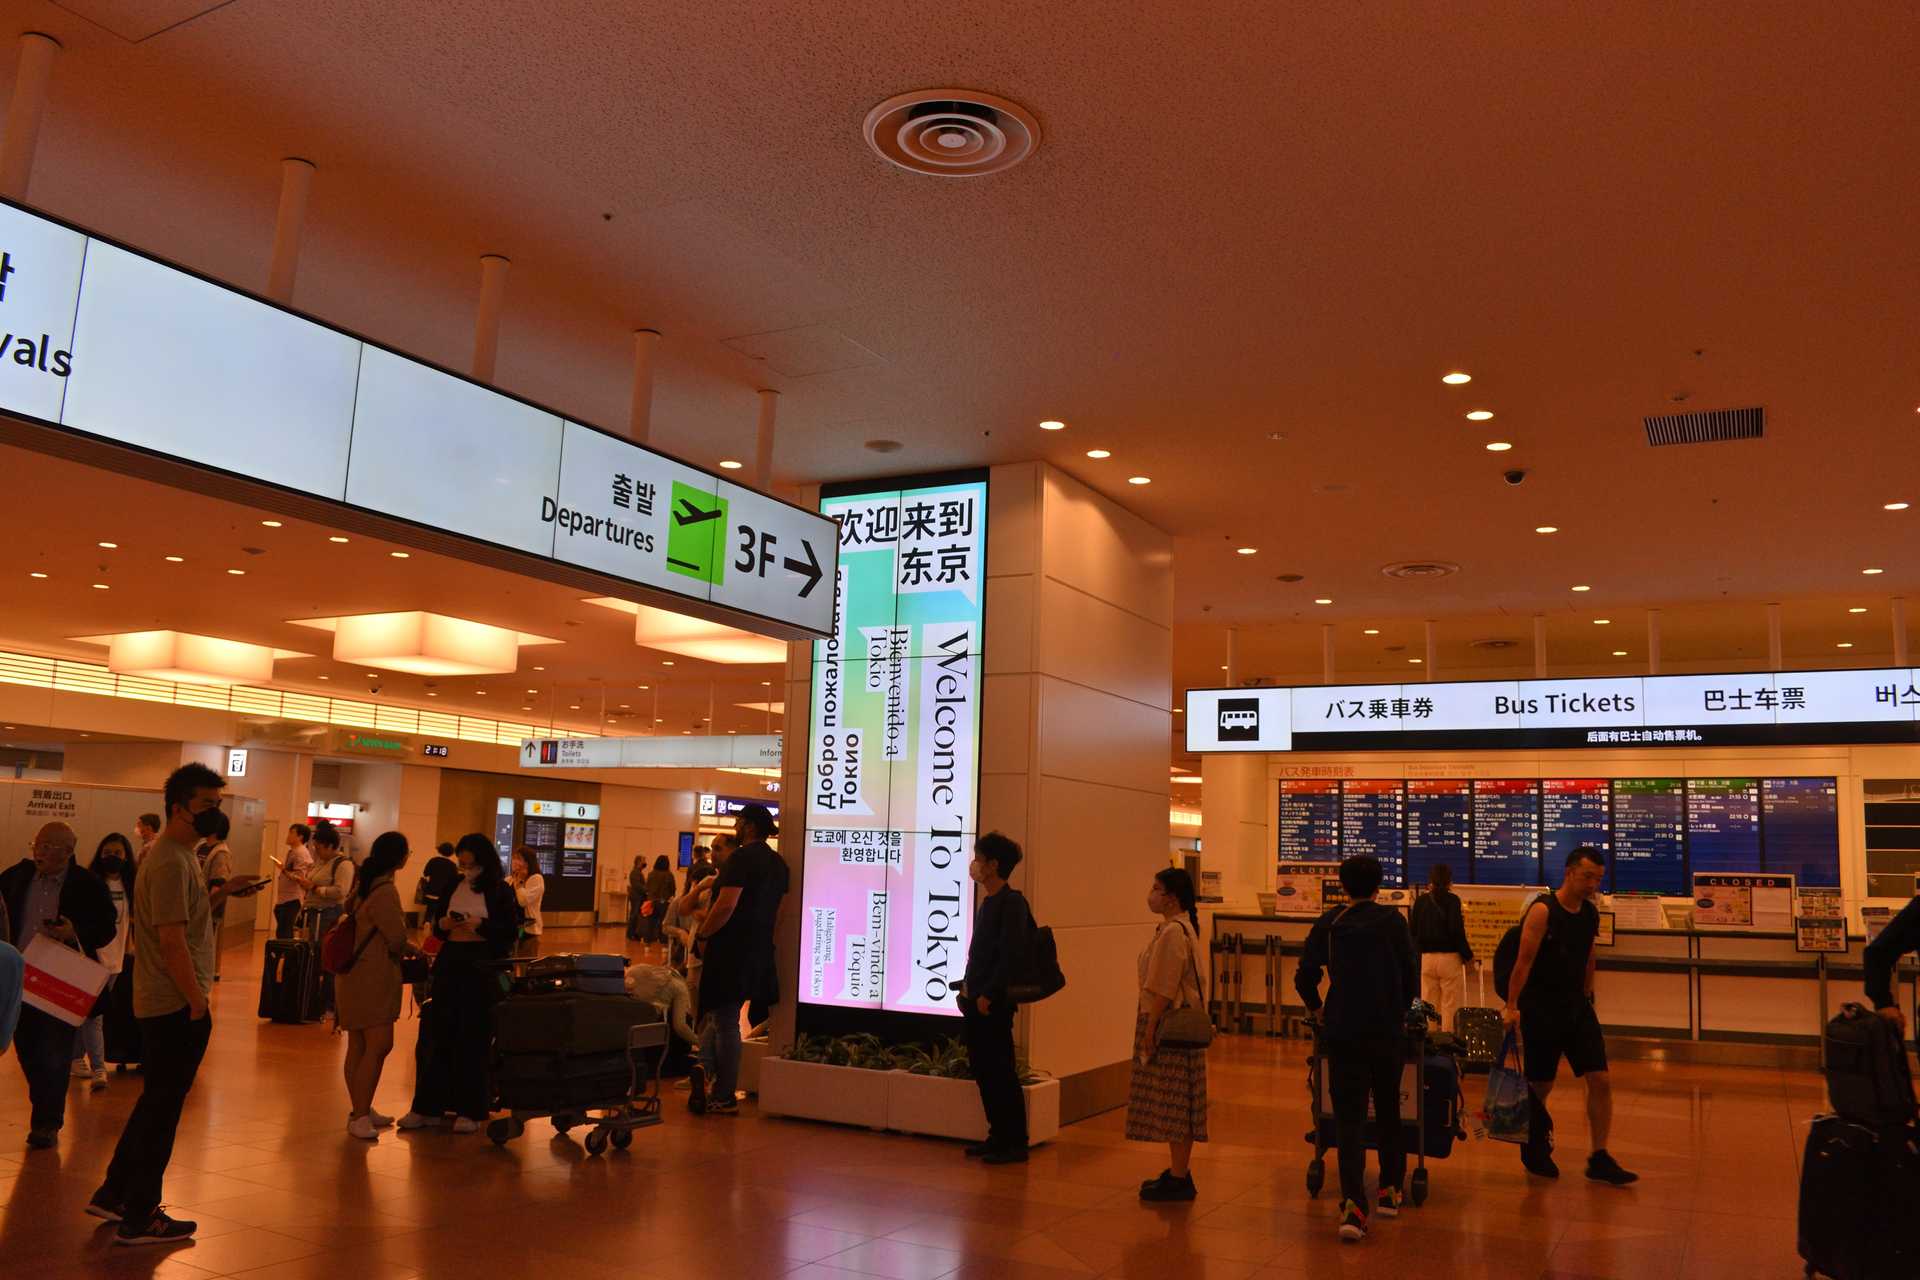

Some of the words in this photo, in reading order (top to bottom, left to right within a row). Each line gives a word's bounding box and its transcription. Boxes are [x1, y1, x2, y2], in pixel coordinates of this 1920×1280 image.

[611, 473, 656, 517] 출발
[541, 496, 655, 553] Departures
[832, 498, 973, 546] 欢迎来到
[734, 524, 778, 578] 3F
[900, 544, 971, 586] 东京
[869, 629, 887, 688] Tokio
[887, 629, 908, 739] Bienvenido
[1495, 695, 1539, 716] Bus
[1546, 692, 1636, 713] Tickets
[1704, 686, 1807, 711] 巴士车票
[1875, 683, 1920, 707] 버스
[932, 630, 969, 805] Welcome
[1325, 697, 1434, 720] バス乗車券
[886, 745, 899, 756] a
[1587, 729, 1702, 742] 后面有巴士自动售票机。
[818, 734, 838, 809] Добро
[839, 733, 859, 809] Токио
[27, 800, 57, 809] Arrival
[59, 802, 75, 810] Exit
[813, 830, 847, 845] 도쿄에
[850, 830, 873, 846] 오신
[878, 831, 902, 847] 것을
[841, 848, 901, 863] 환영합니다
[929, 815, 963, 869] To
[1709, 878, 1776, 886] CLOSED
[916, 880, 961, 1001] Tokyo
[848, 937, 866, 997] Tóquio
[869, 989, 880, 998] a
